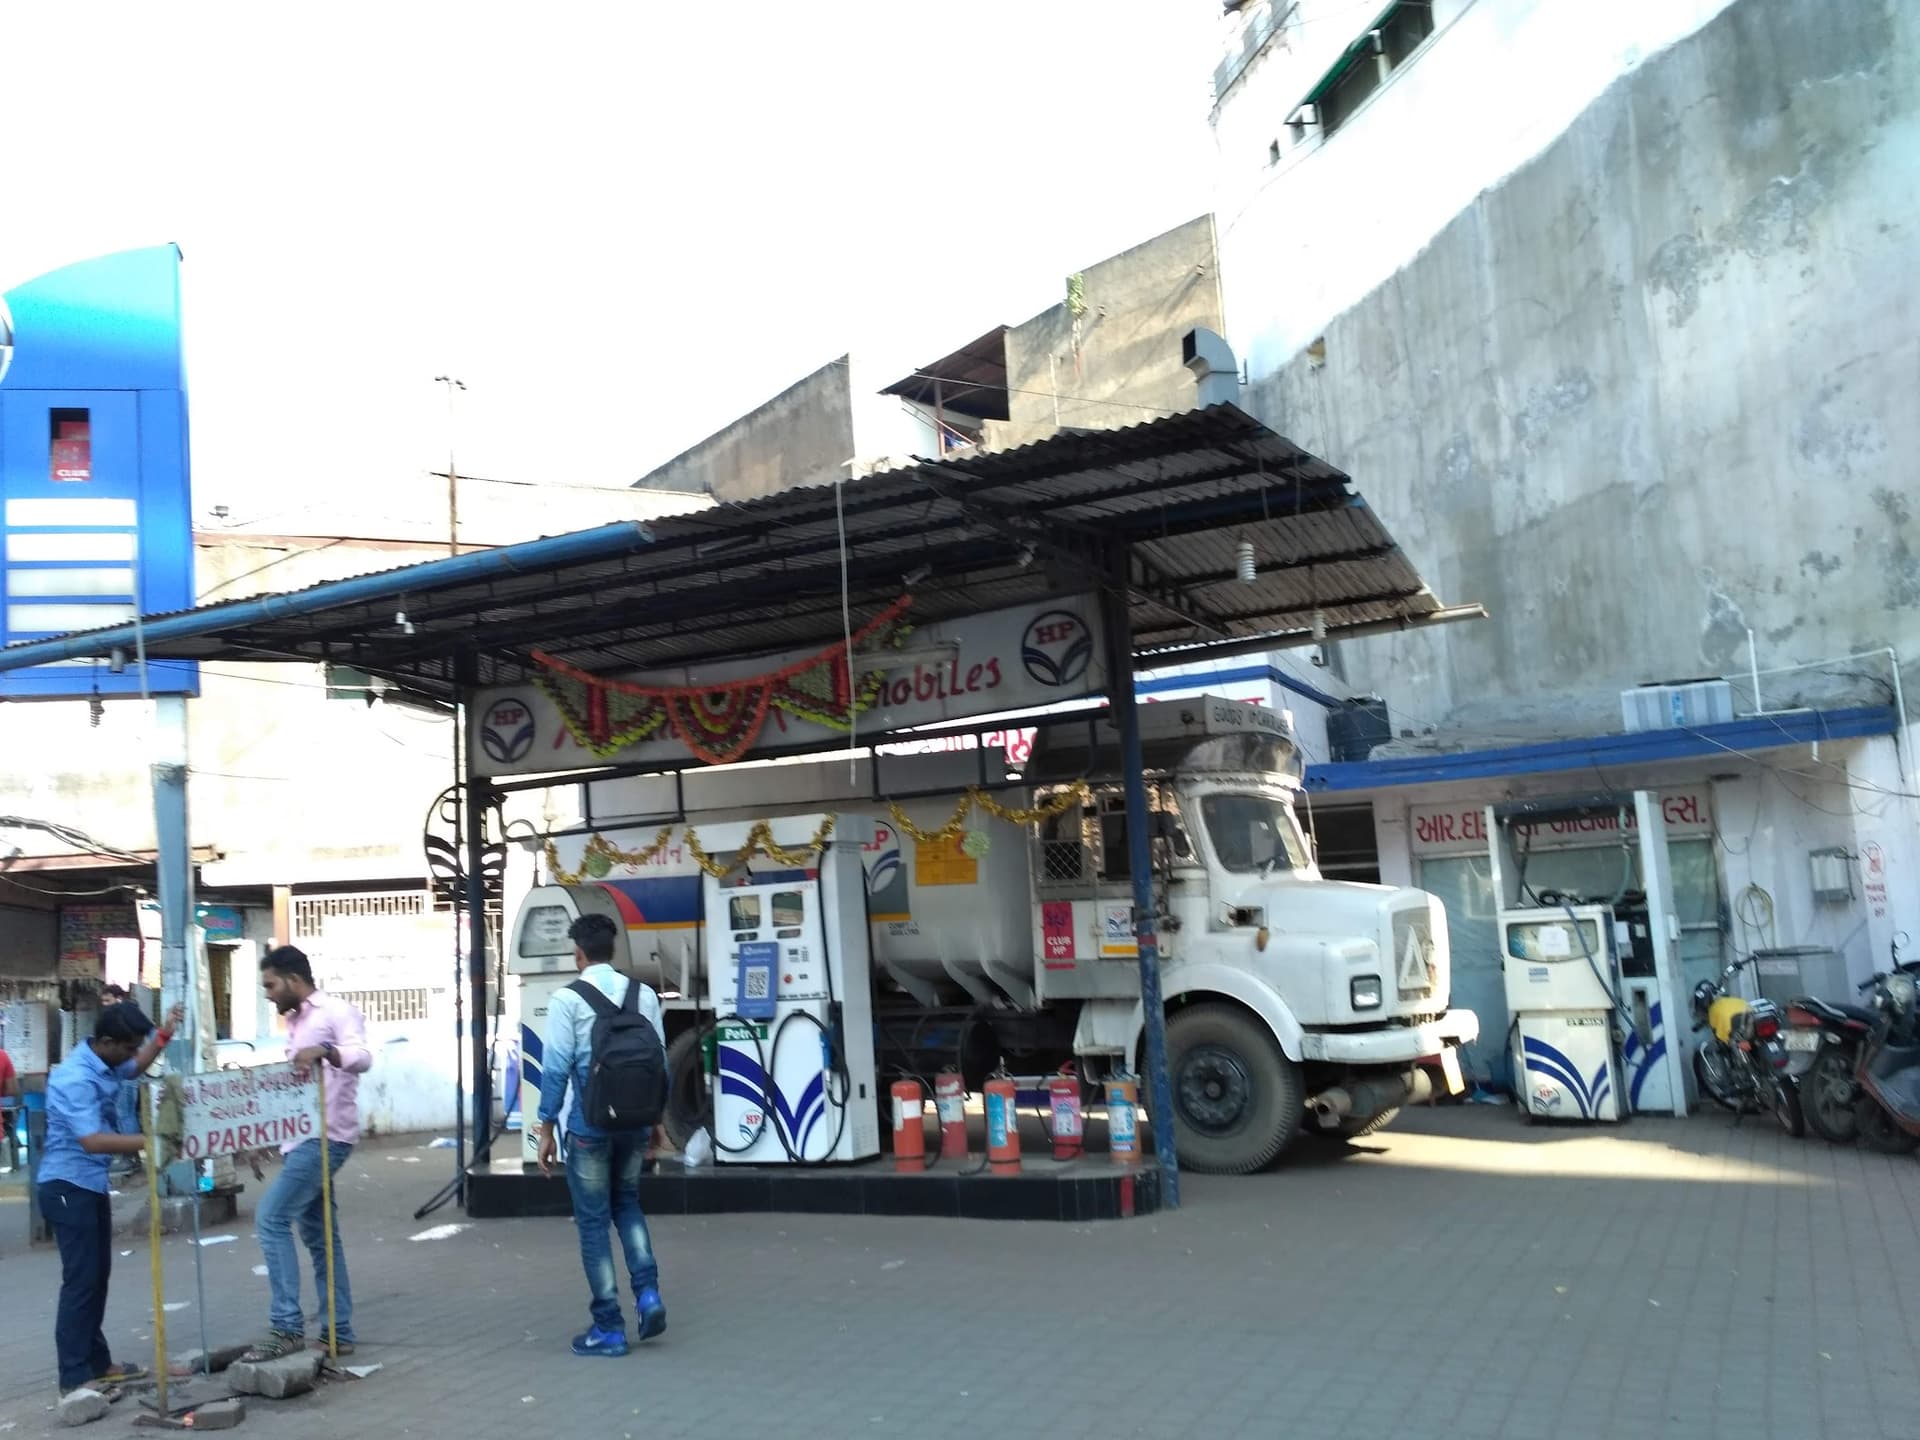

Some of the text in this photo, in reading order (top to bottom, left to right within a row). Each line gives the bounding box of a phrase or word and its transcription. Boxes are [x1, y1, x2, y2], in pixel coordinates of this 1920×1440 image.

[1035, 620, 1075, 645] HP
[495, 708, 524, 726] HP
[1046, 936, 1072, 946] CLUB
[1052, 946, 1067, 955] HP
[725, 1026, 761, 1041] Petrl
[746, 1114, 761, 1125] HP
[207, 1113, 312, 1155] PARKING
